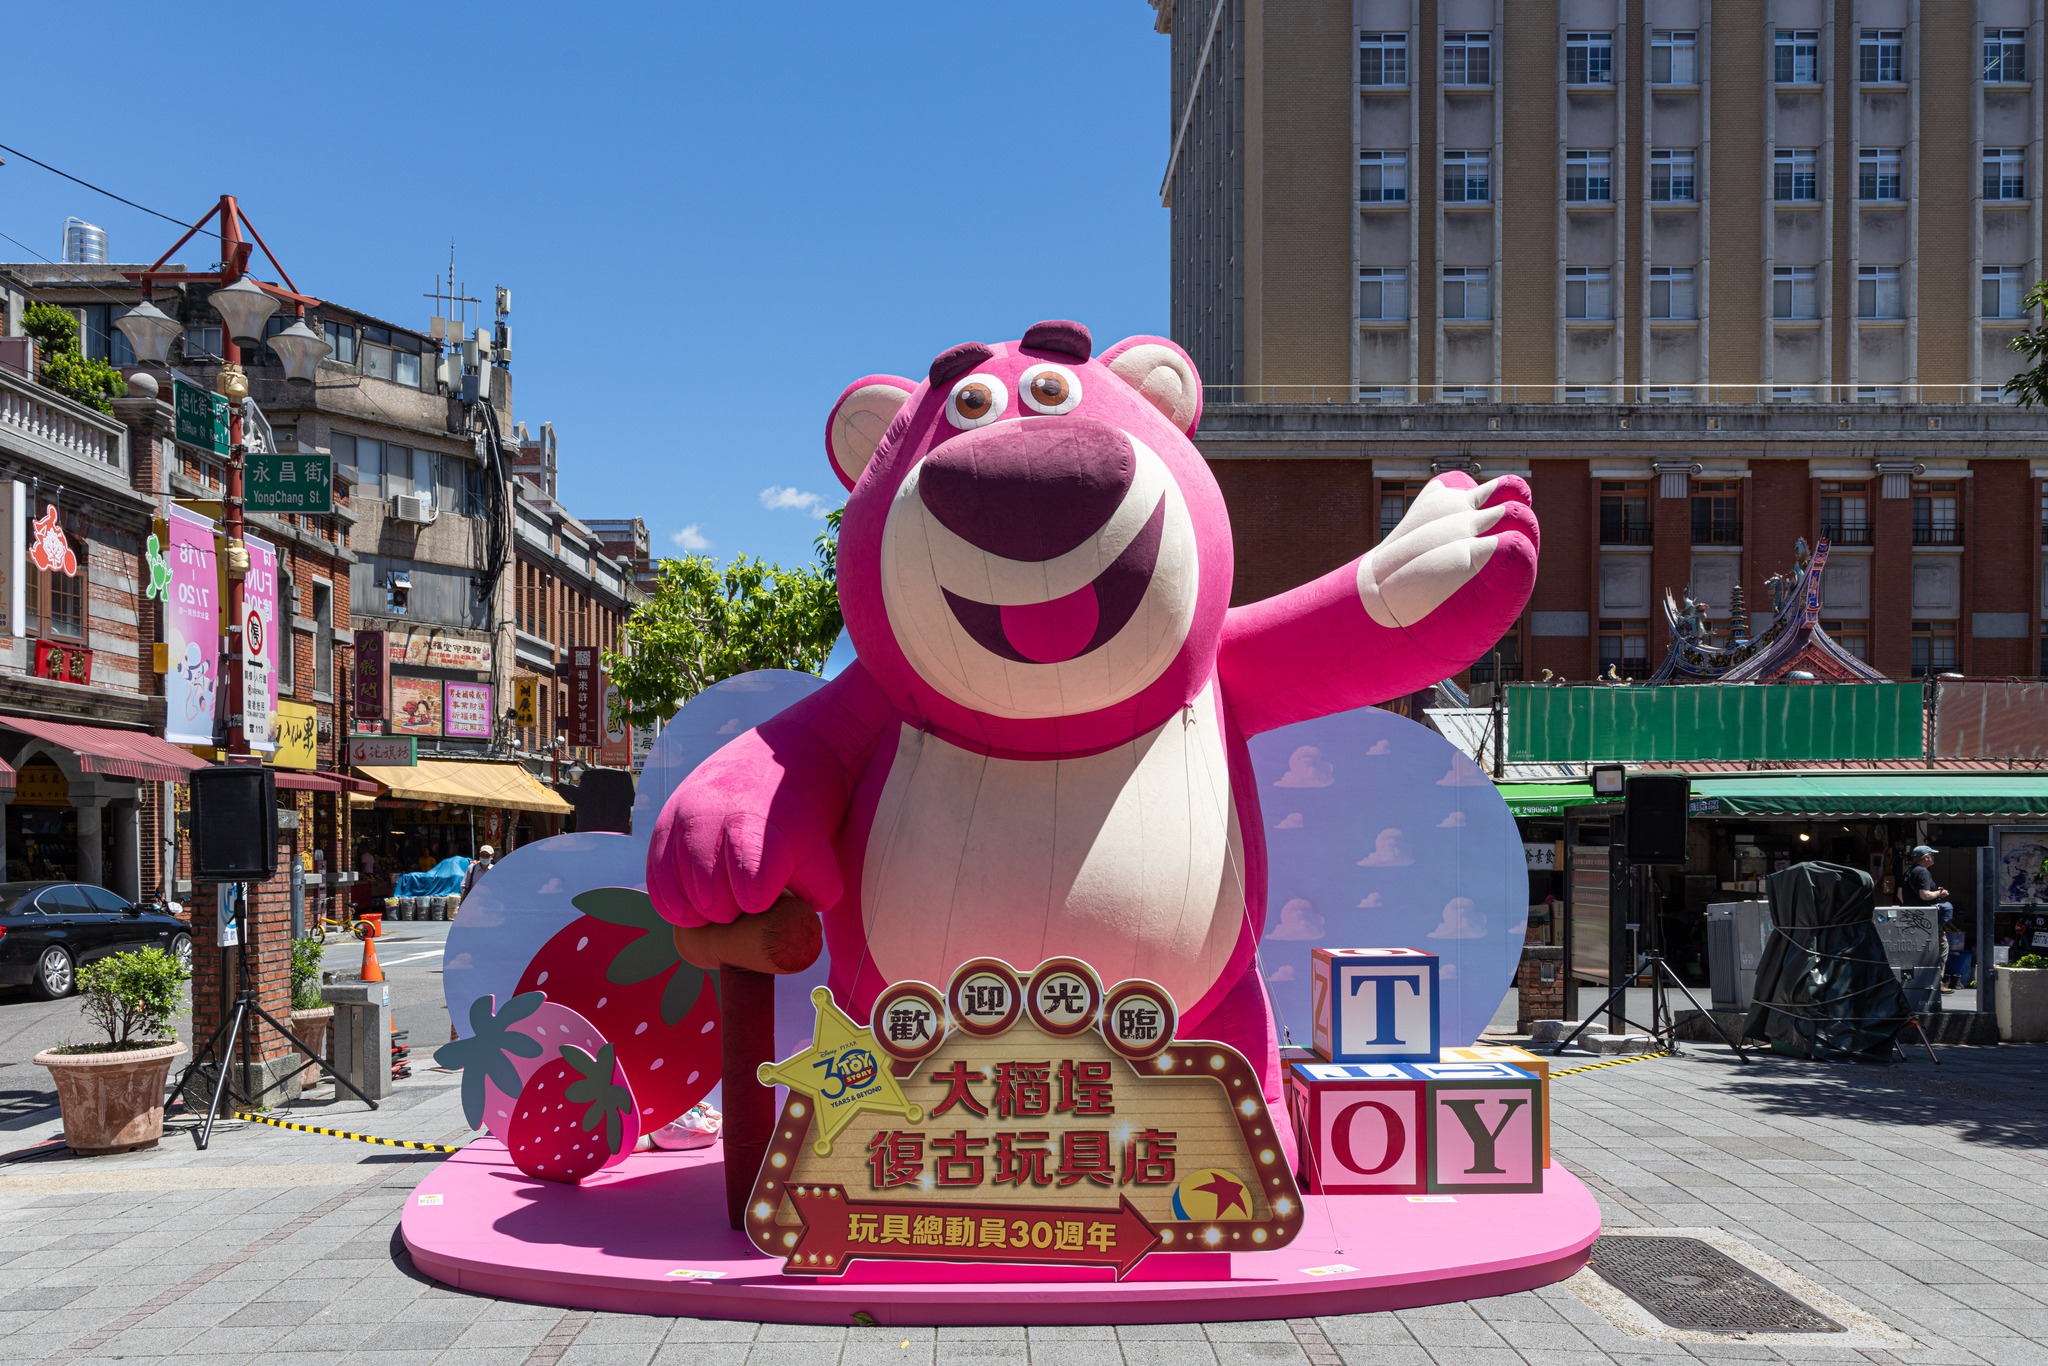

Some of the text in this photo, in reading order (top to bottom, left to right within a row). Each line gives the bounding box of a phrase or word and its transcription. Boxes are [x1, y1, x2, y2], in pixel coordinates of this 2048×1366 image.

[253, 461, 323, 483] 永昌街
[253, 490, 322, 506] YongChang St.
[889, 983, 1159, 1041] 歡迎光臨
[1350, 974, 1421, 1046] T
[839, 1041, 858, 1051] PIXAR
[837, 1051, 872, 1077] TOY
[846, 1068, 873, 1083] STORY
[830, 1097, 851, 1109] YEARS
[856, 1085, 883, 1100] BEYOND
[932, 1059, 1116, 1119] 大稻埕
[1331, 1098, 1528, 1175] O Y
[869, 1128, 1178, 1187] 復古玩具店
[847, 1212, 1118, 1253] 玩具總動員30週年
